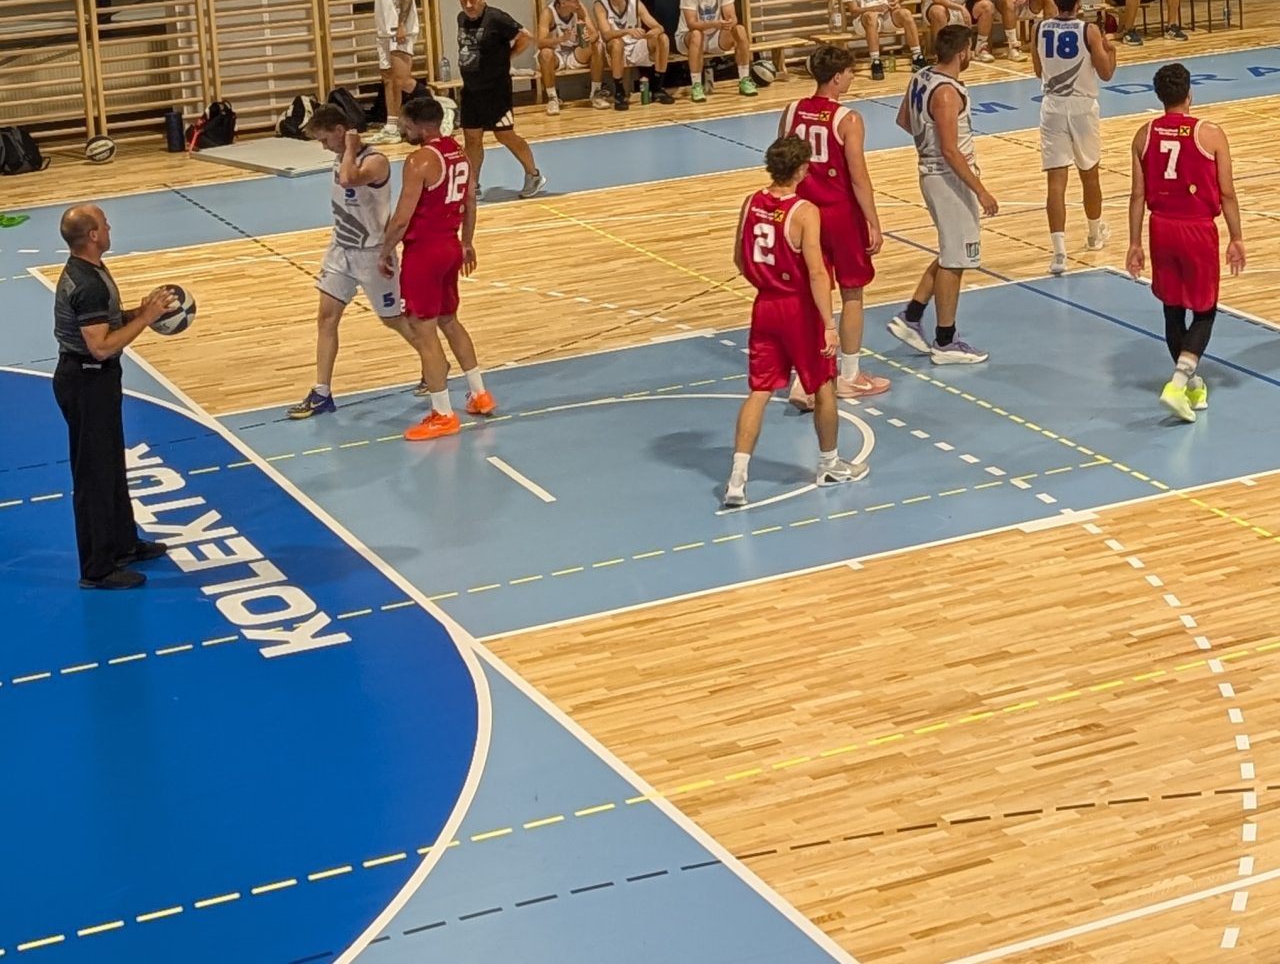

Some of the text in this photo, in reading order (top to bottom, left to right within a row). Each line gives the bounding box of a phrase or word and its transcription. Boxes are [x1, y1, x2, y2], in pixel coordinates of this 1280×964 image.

[1042, 30, 1079, 59] 18
[1160, 140, 1181, 180] 7
[445, 161, 469, 205] 12
[753, 222, 775, 266] 2
[383, 291, 395, 308] 5
